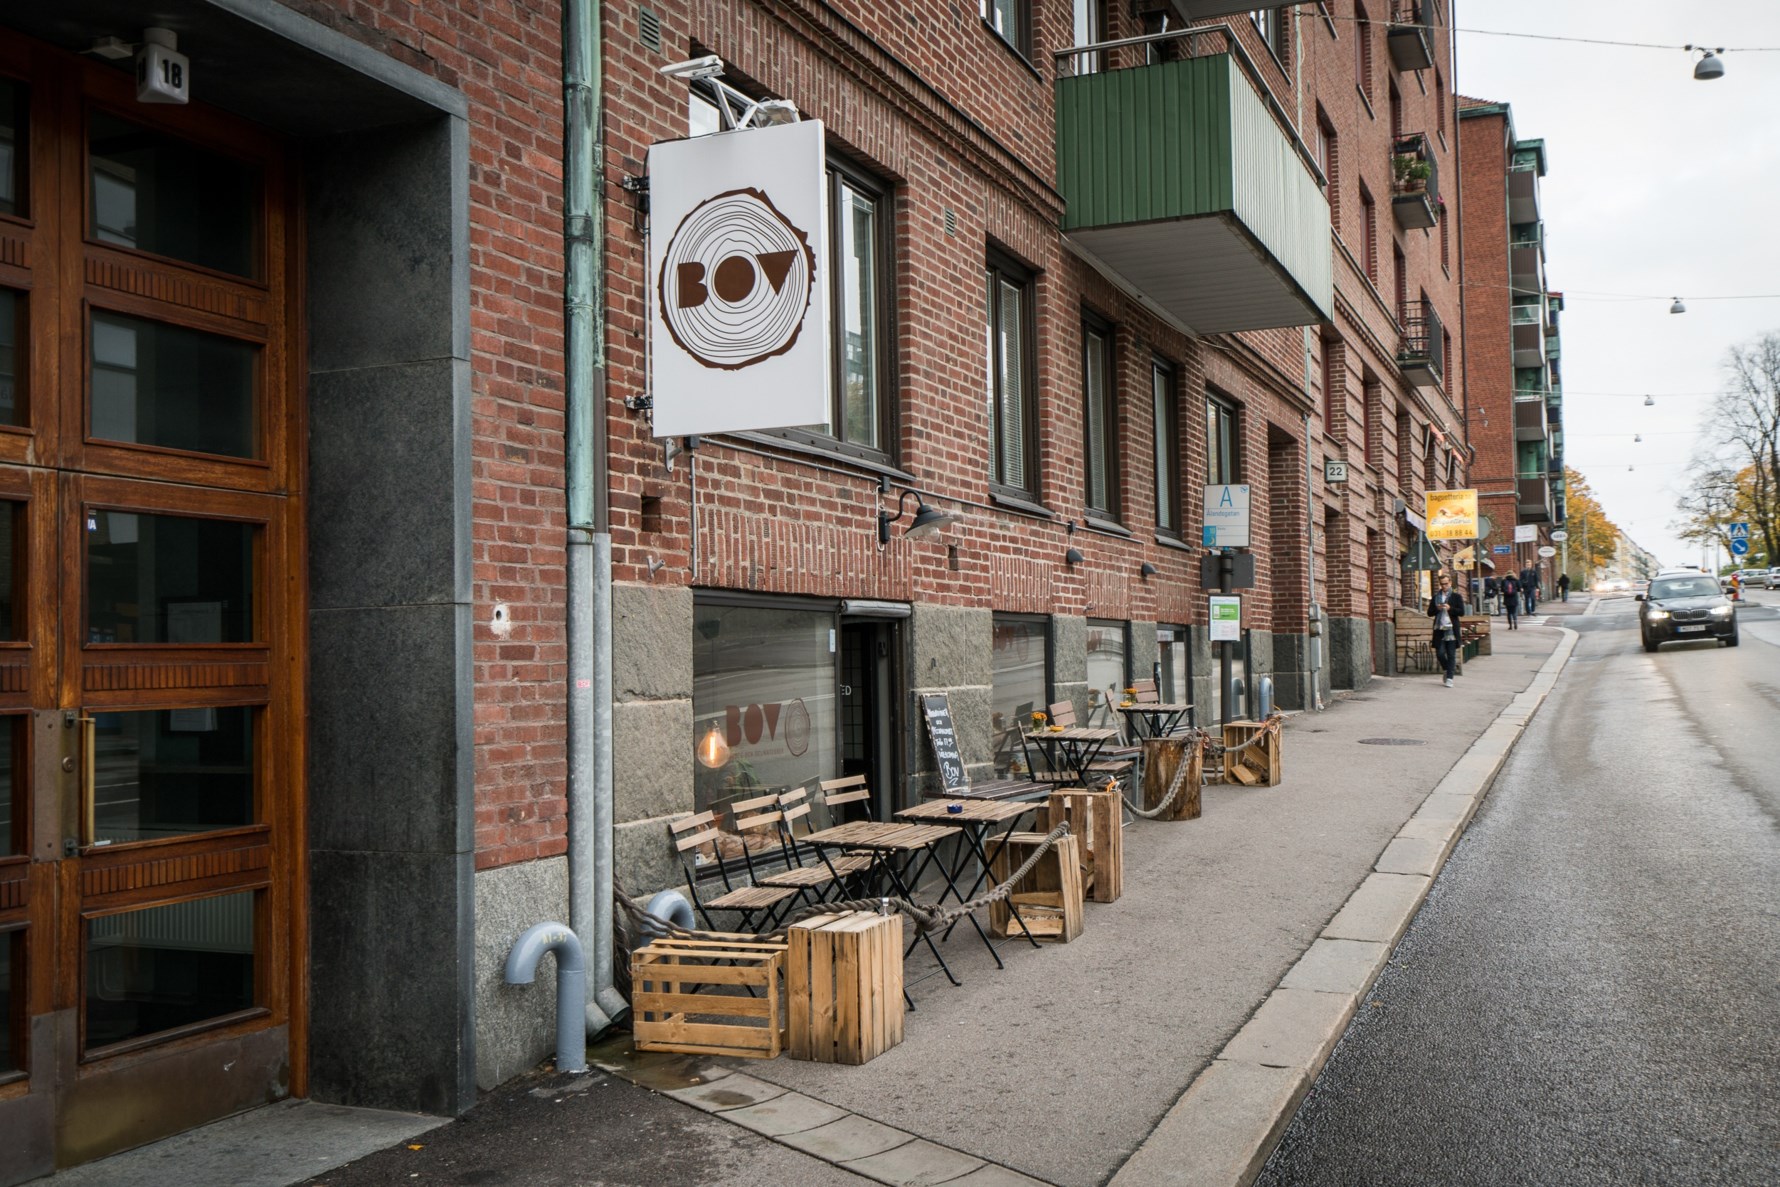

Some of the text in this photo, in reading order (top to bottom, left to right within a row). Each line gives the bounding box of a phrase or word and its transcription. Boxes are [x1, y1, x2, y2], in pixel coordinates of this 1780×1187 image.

[162, 59, 183, 89] 18
[678, 249, 799, 309] BOV
[1329, 466, 1343, 477] 22
[1219, 486, 1233, 508] A
[725, 703, 782, 747] BOV
